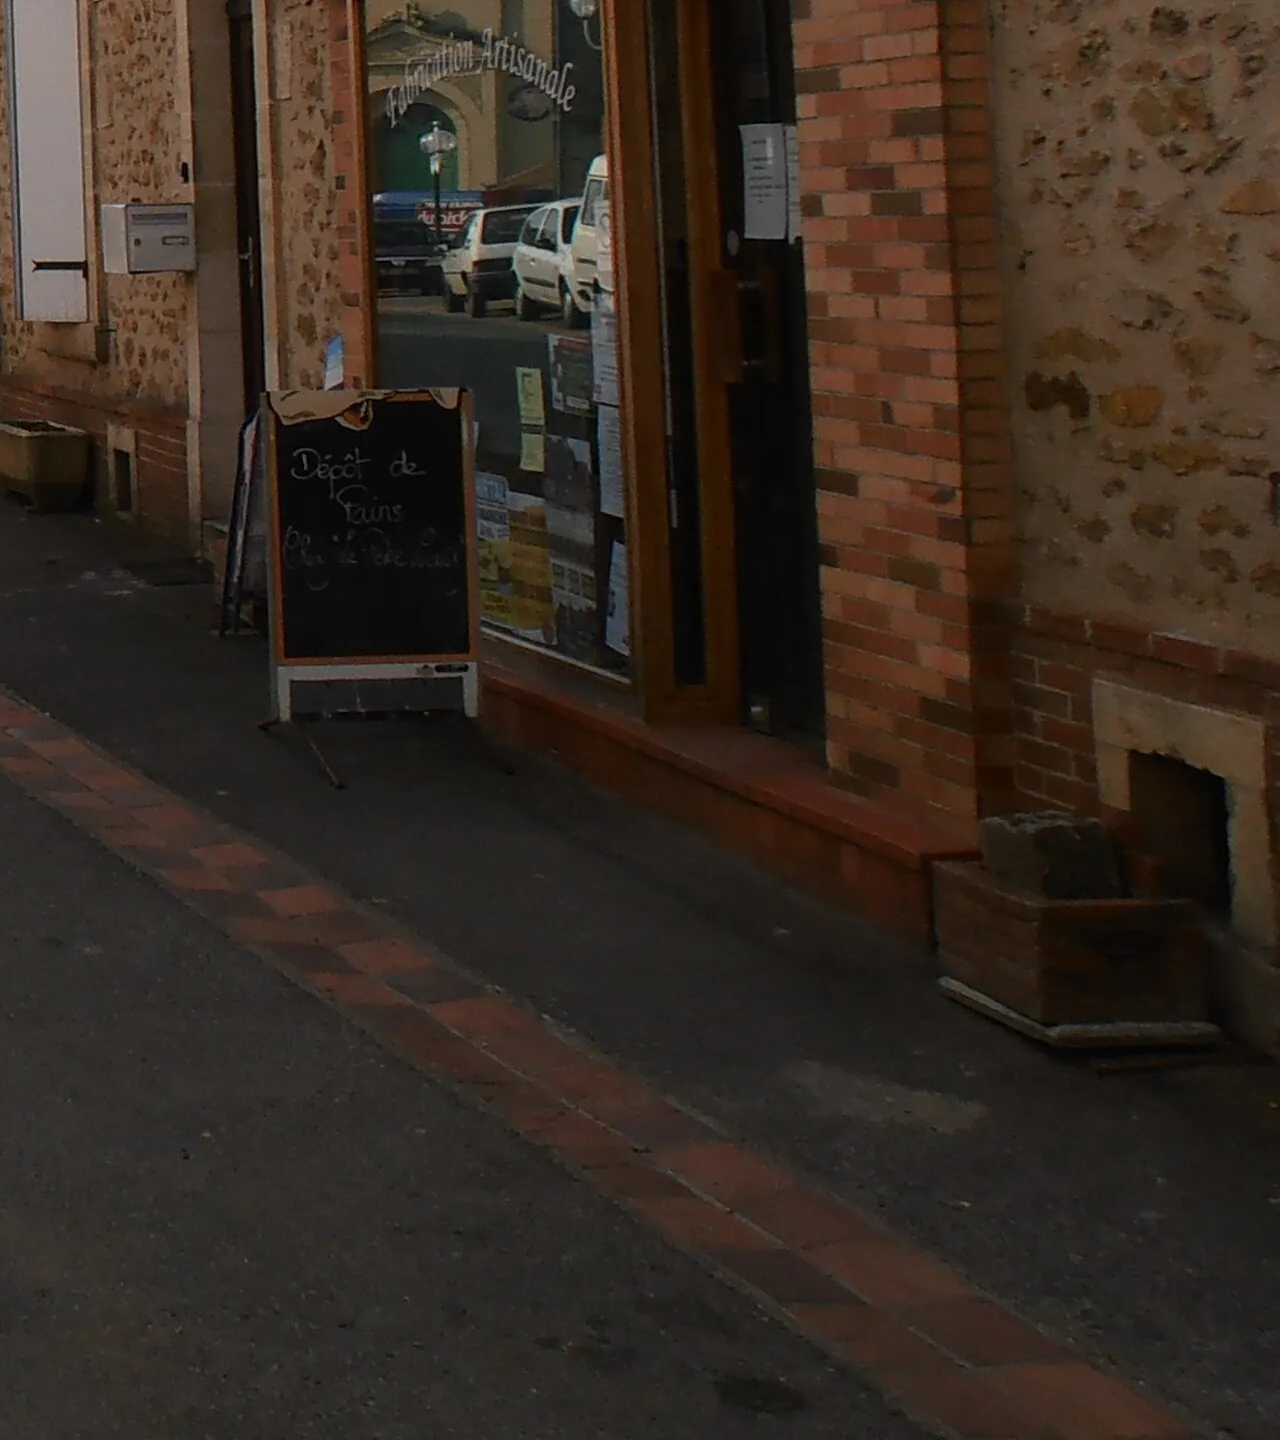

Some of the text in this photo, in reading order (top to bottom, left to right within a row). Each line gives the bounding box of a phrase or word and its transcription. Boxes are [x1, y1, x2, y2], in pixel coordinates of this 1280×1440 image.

[385, 27, 577, 128] Fabrication Artisanale
[290, 446, 428, 500] Dépôt de
